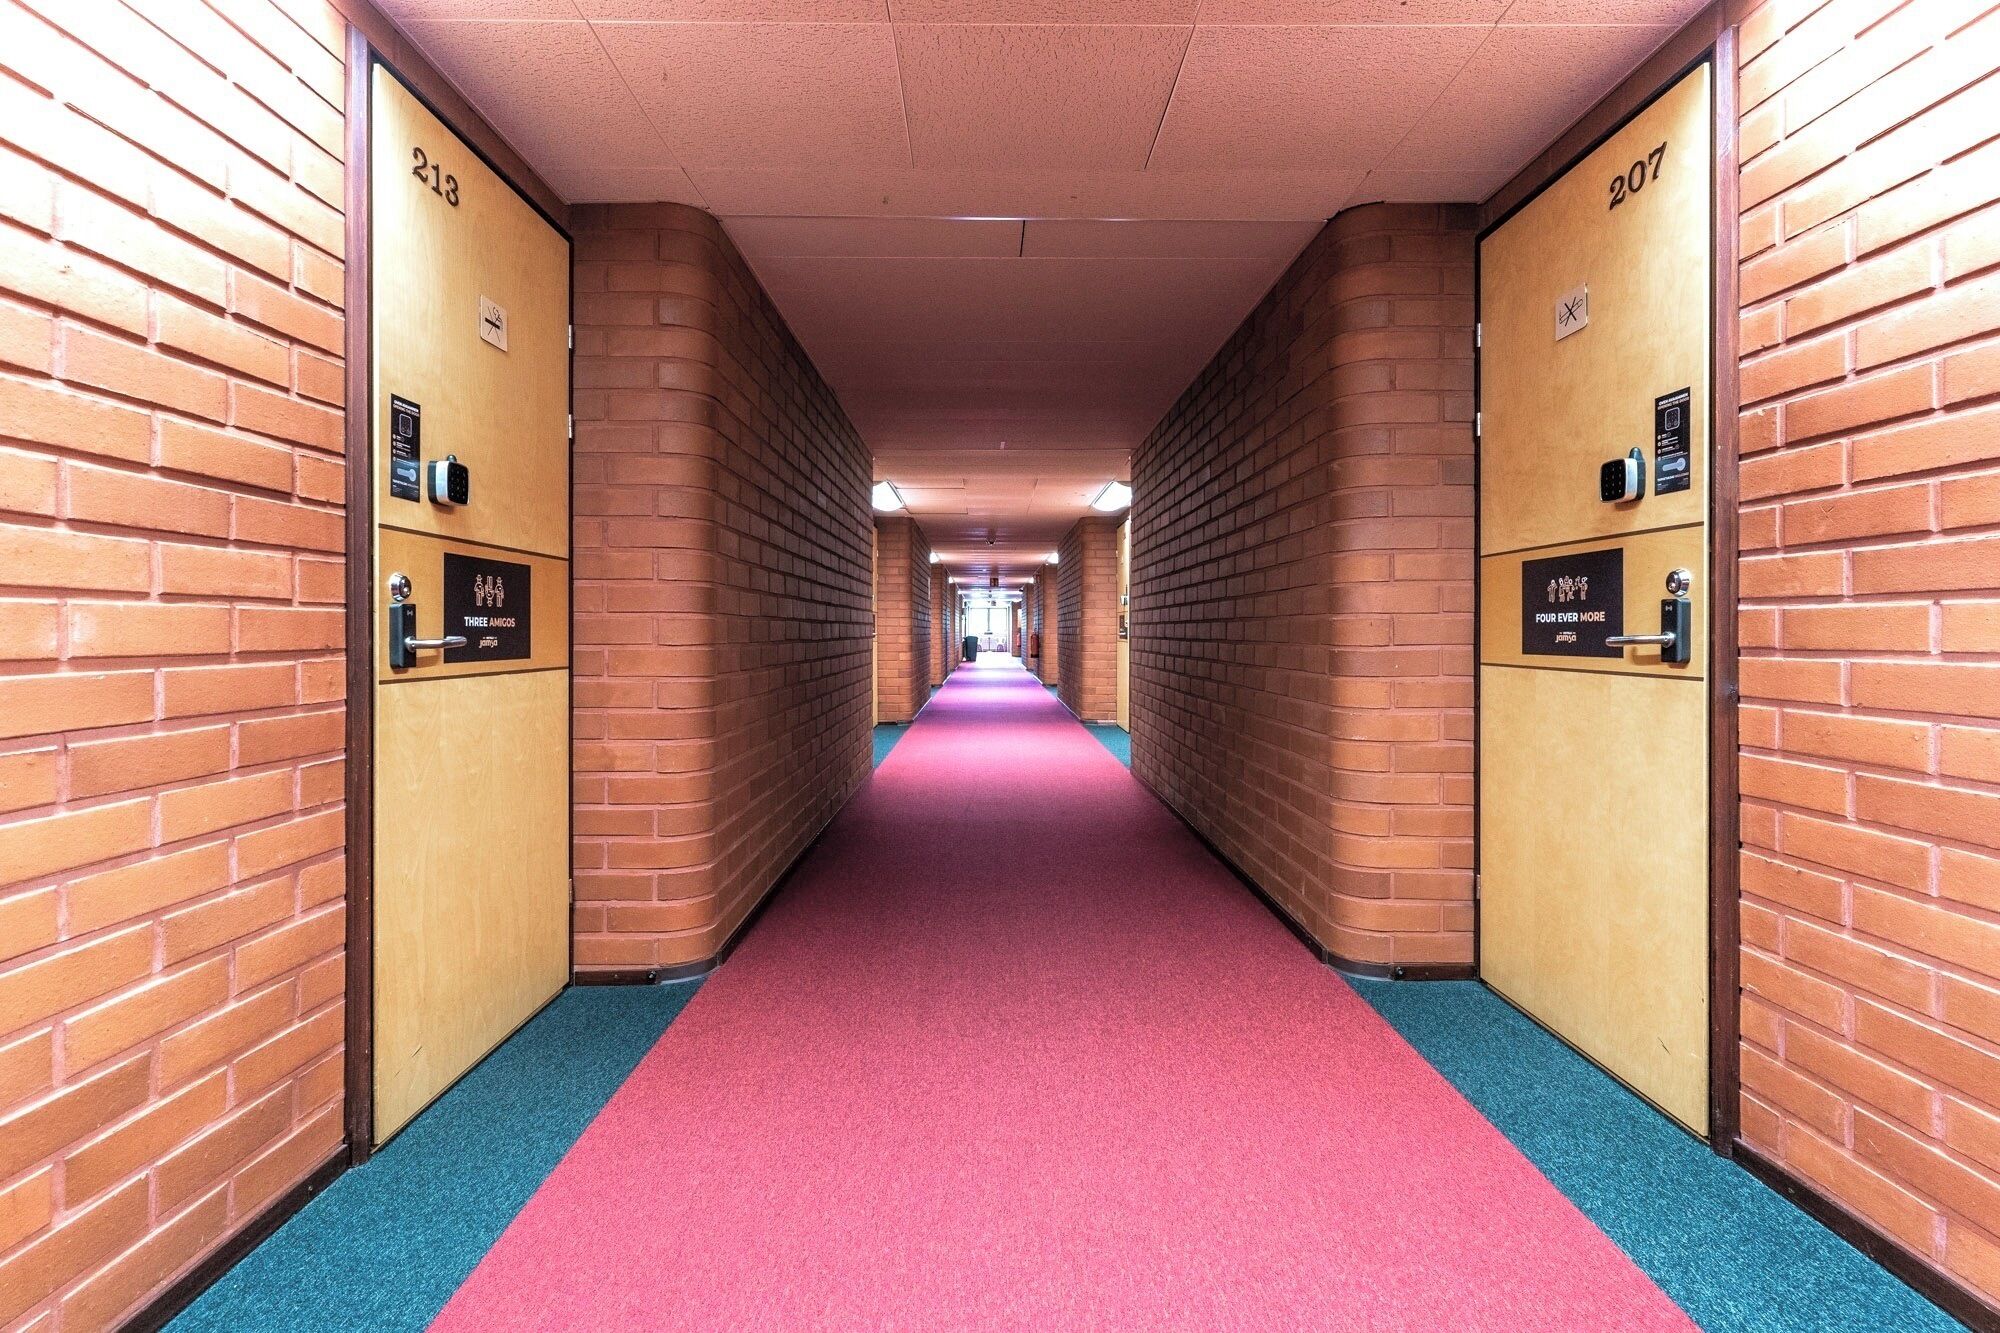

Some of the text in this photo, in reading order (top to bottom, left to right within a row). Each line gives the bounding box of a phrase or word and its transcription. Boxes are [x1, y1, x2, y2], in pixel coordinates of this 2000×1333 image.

[412, 146, 460, 207] 213
[1608, 140, 1668, 211] 207
[464, 616, 516, 628] THREE AMIGOS
[1535, 611, 1606, 623] FOUR EVER MORE
